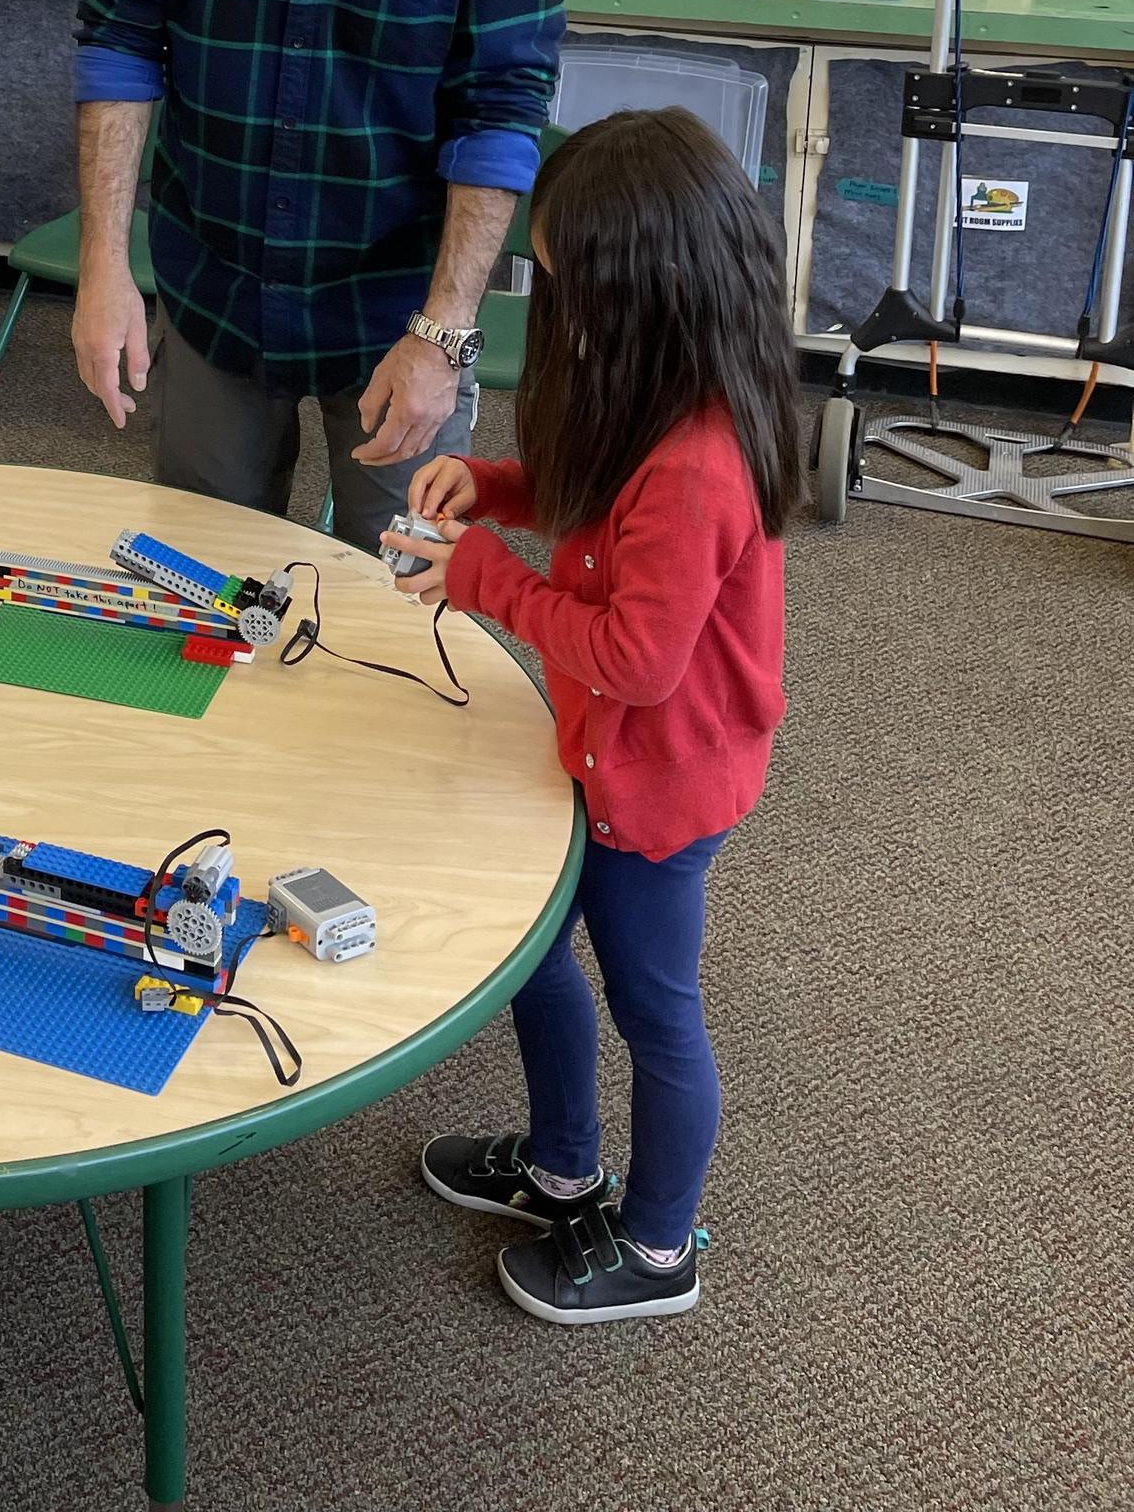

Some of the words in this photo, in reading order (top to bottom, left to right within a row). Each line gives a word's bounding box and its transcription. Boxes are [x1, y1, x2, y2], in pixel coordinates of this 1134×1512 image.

[969, 217, 991, 225] ROOM
[992, 219, 1023, 227] SUPPLIES
[18, 578, 33, 590] Do
[36, 584, 61, 595] NOT
[65, 590, 89, 601] take
